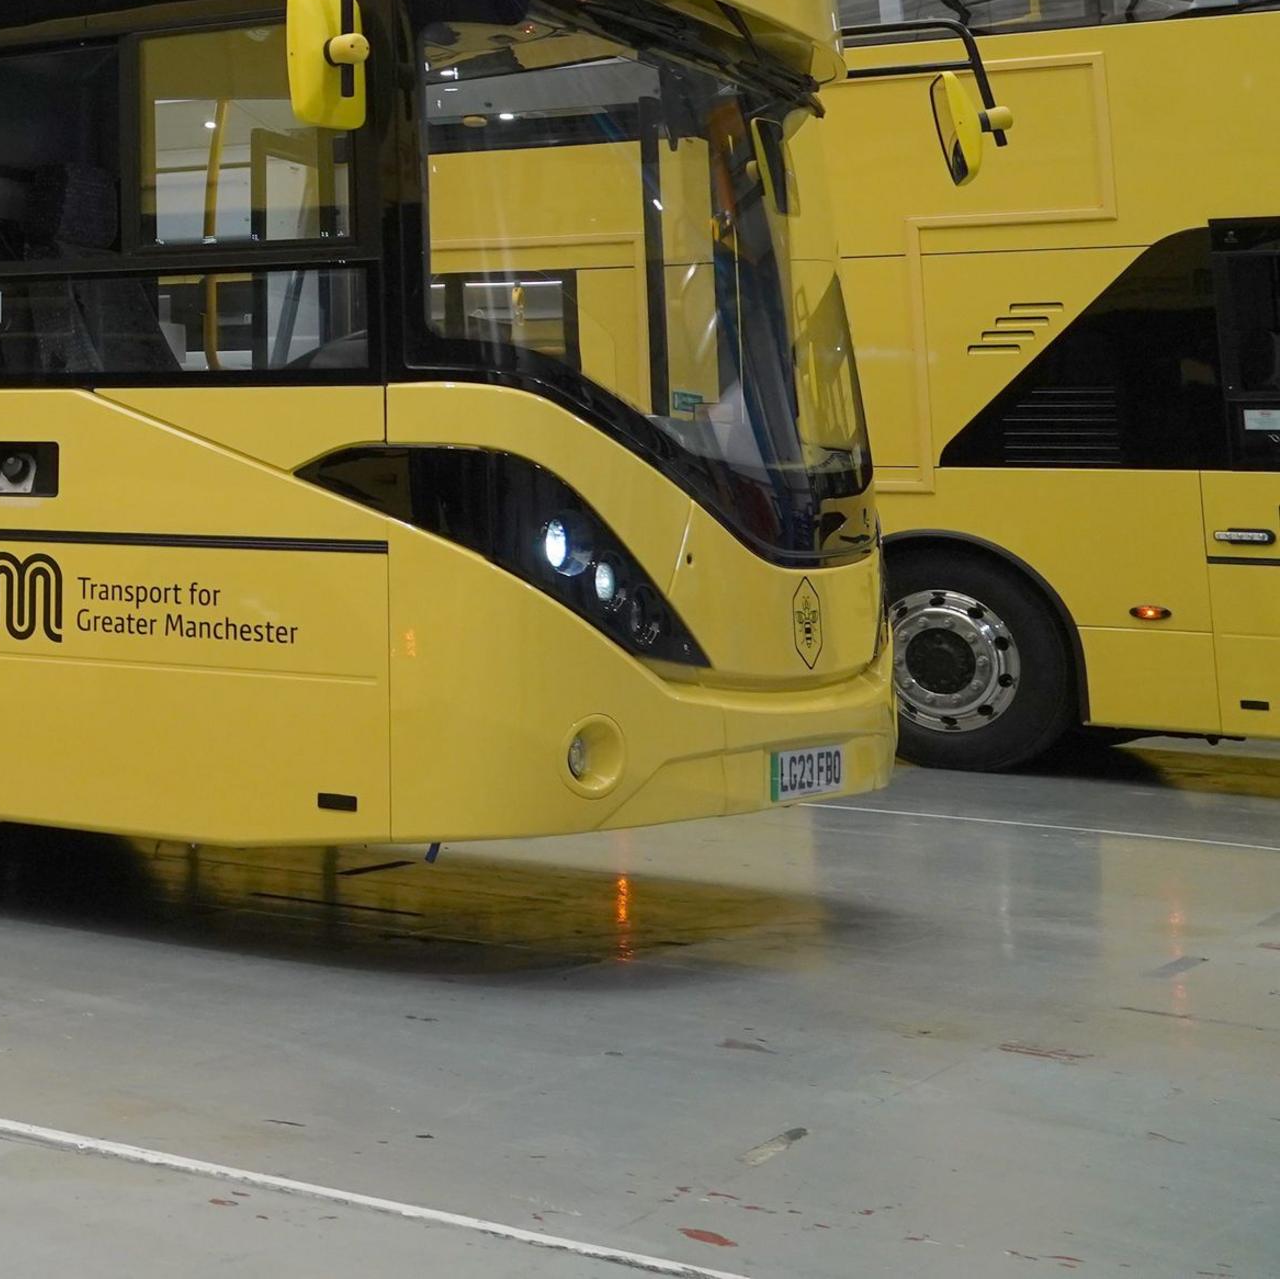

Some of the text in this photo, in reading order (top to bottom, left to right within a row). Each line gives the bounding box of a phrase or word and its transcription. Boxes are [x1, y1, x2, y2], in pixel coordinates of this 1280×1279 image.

[77, 576, 221, 609] Transport for
[76, 608, 298, 644] Greater Manchester
[780, 750, 841, 792] LG23 FBO
